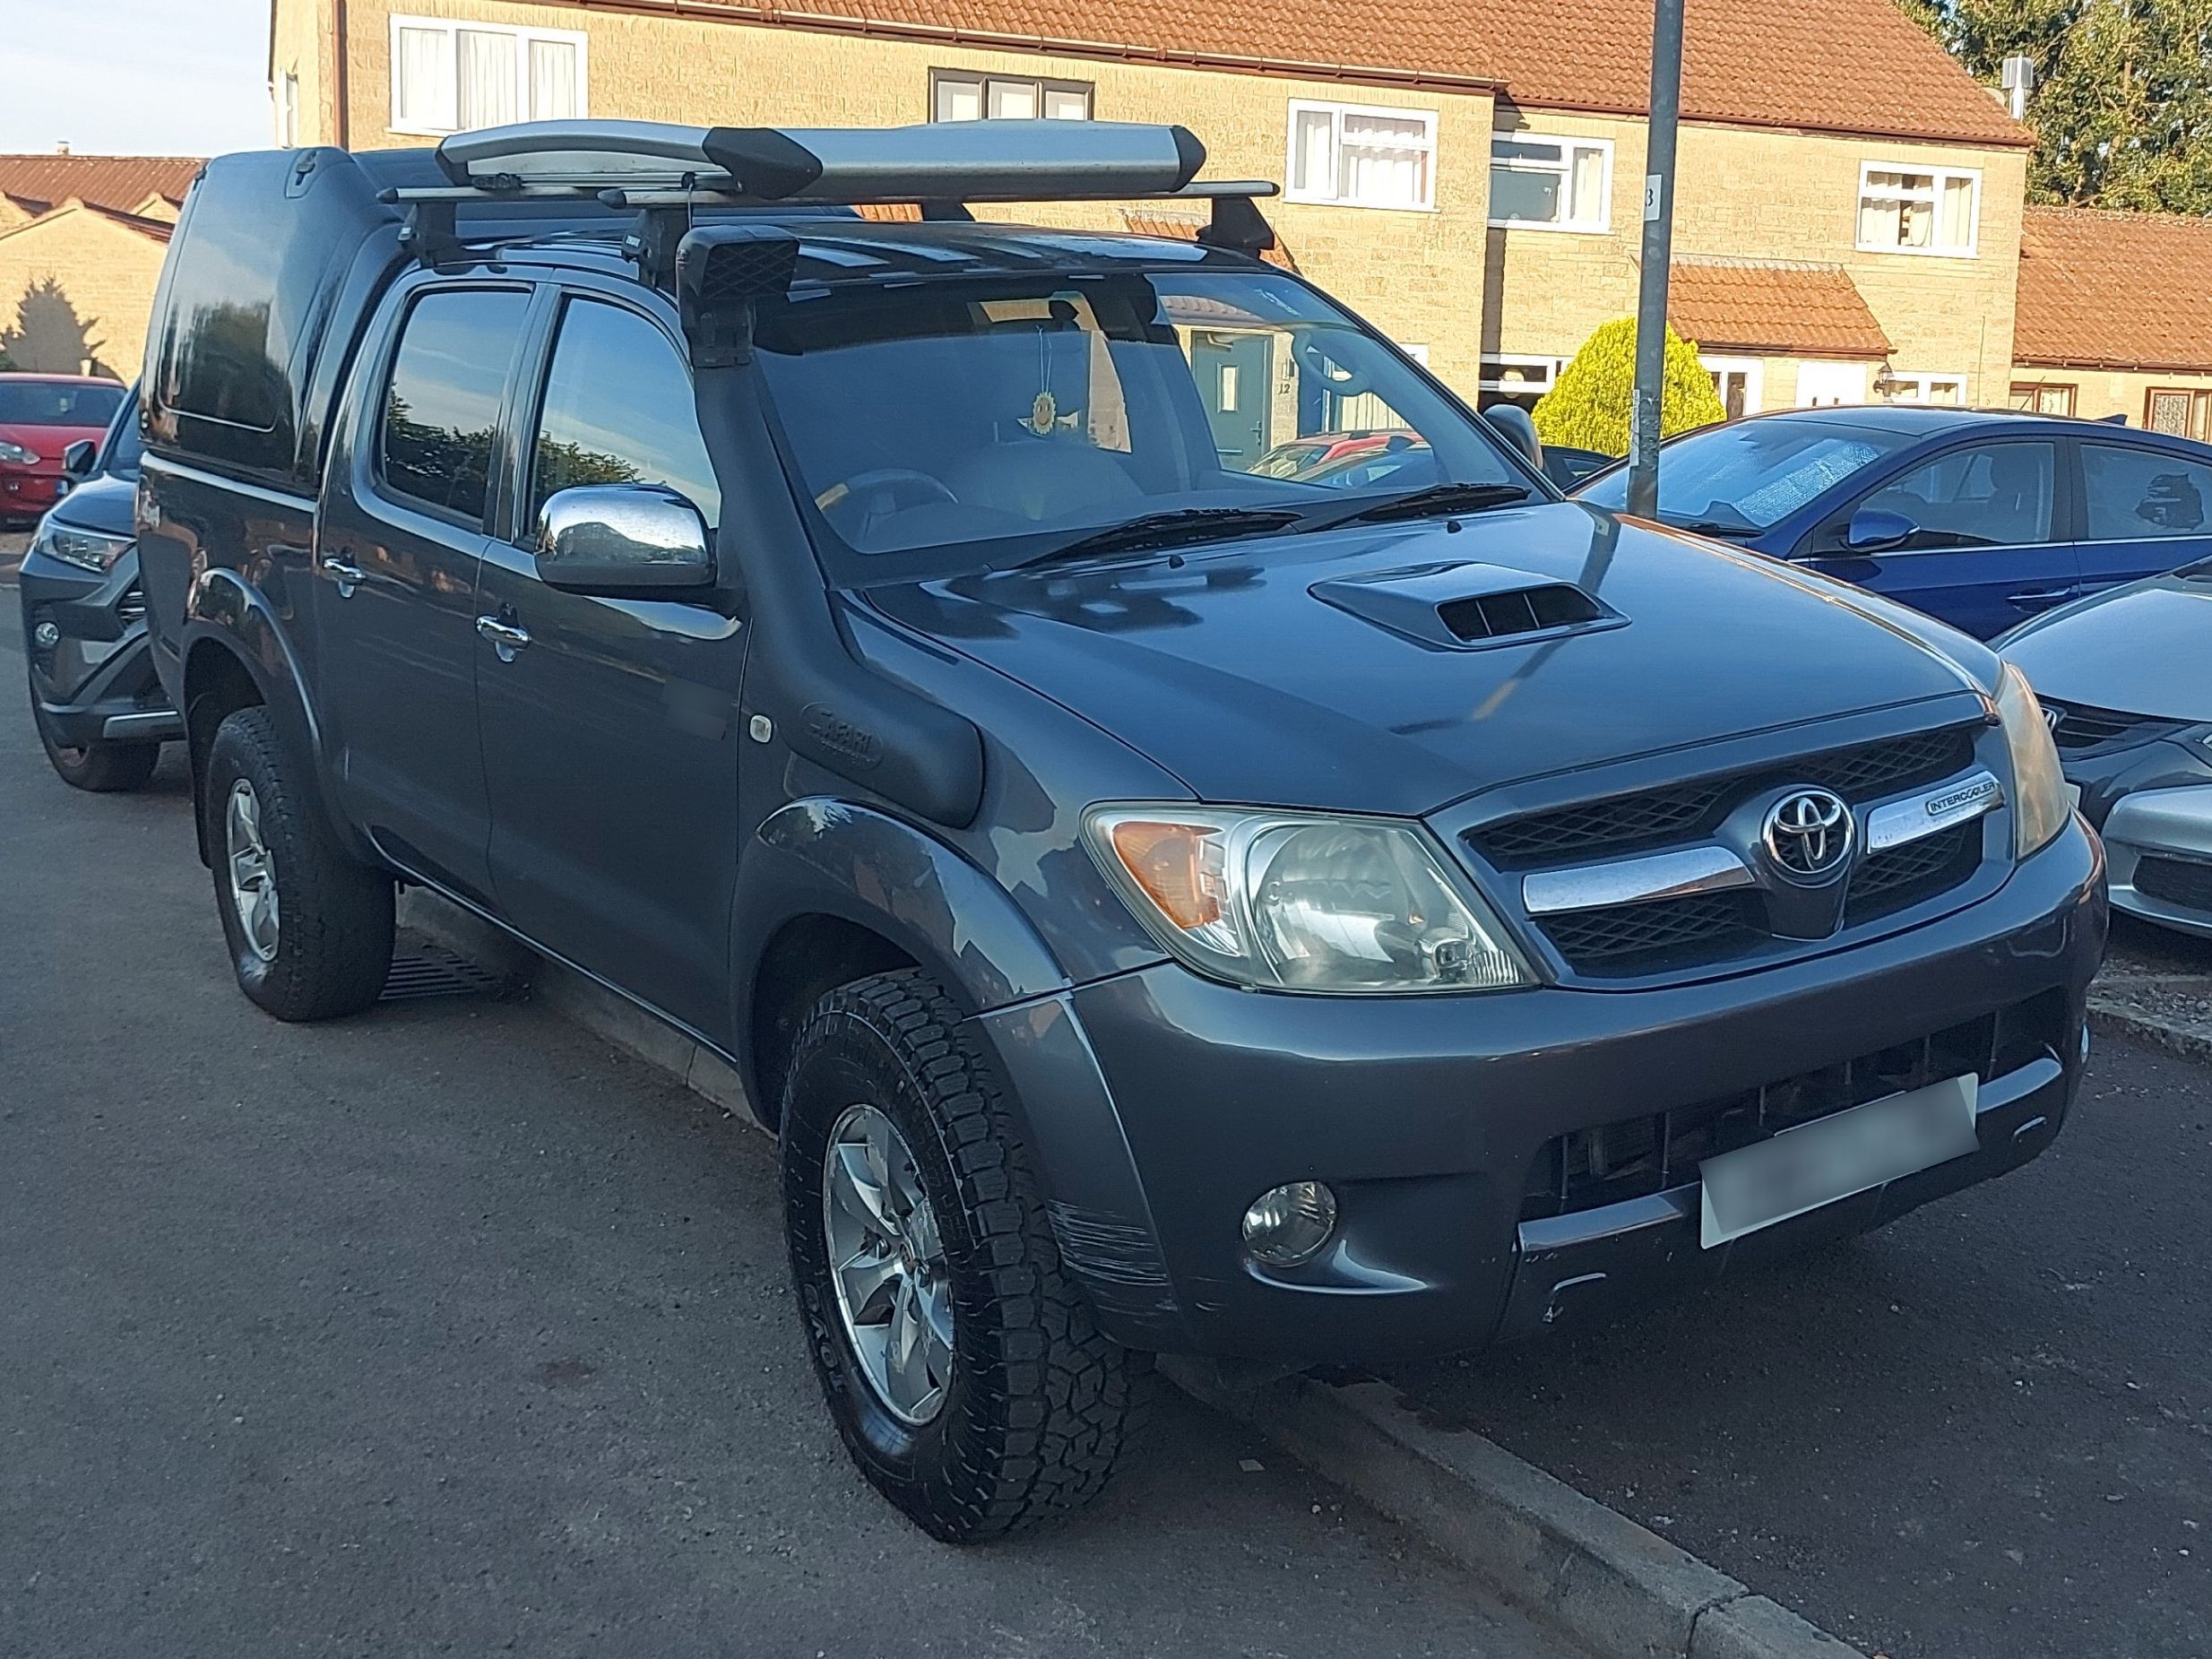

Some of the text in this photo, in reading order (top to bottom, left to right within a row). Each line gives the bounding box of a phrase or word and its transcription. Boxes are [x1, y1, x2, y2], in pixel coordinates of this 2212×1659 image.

[1278, 384, 1291, 395] 12
[1931, 782, 1995, 812] INTERCOOLER
[804, 1283, 844, 1392] TOYO
